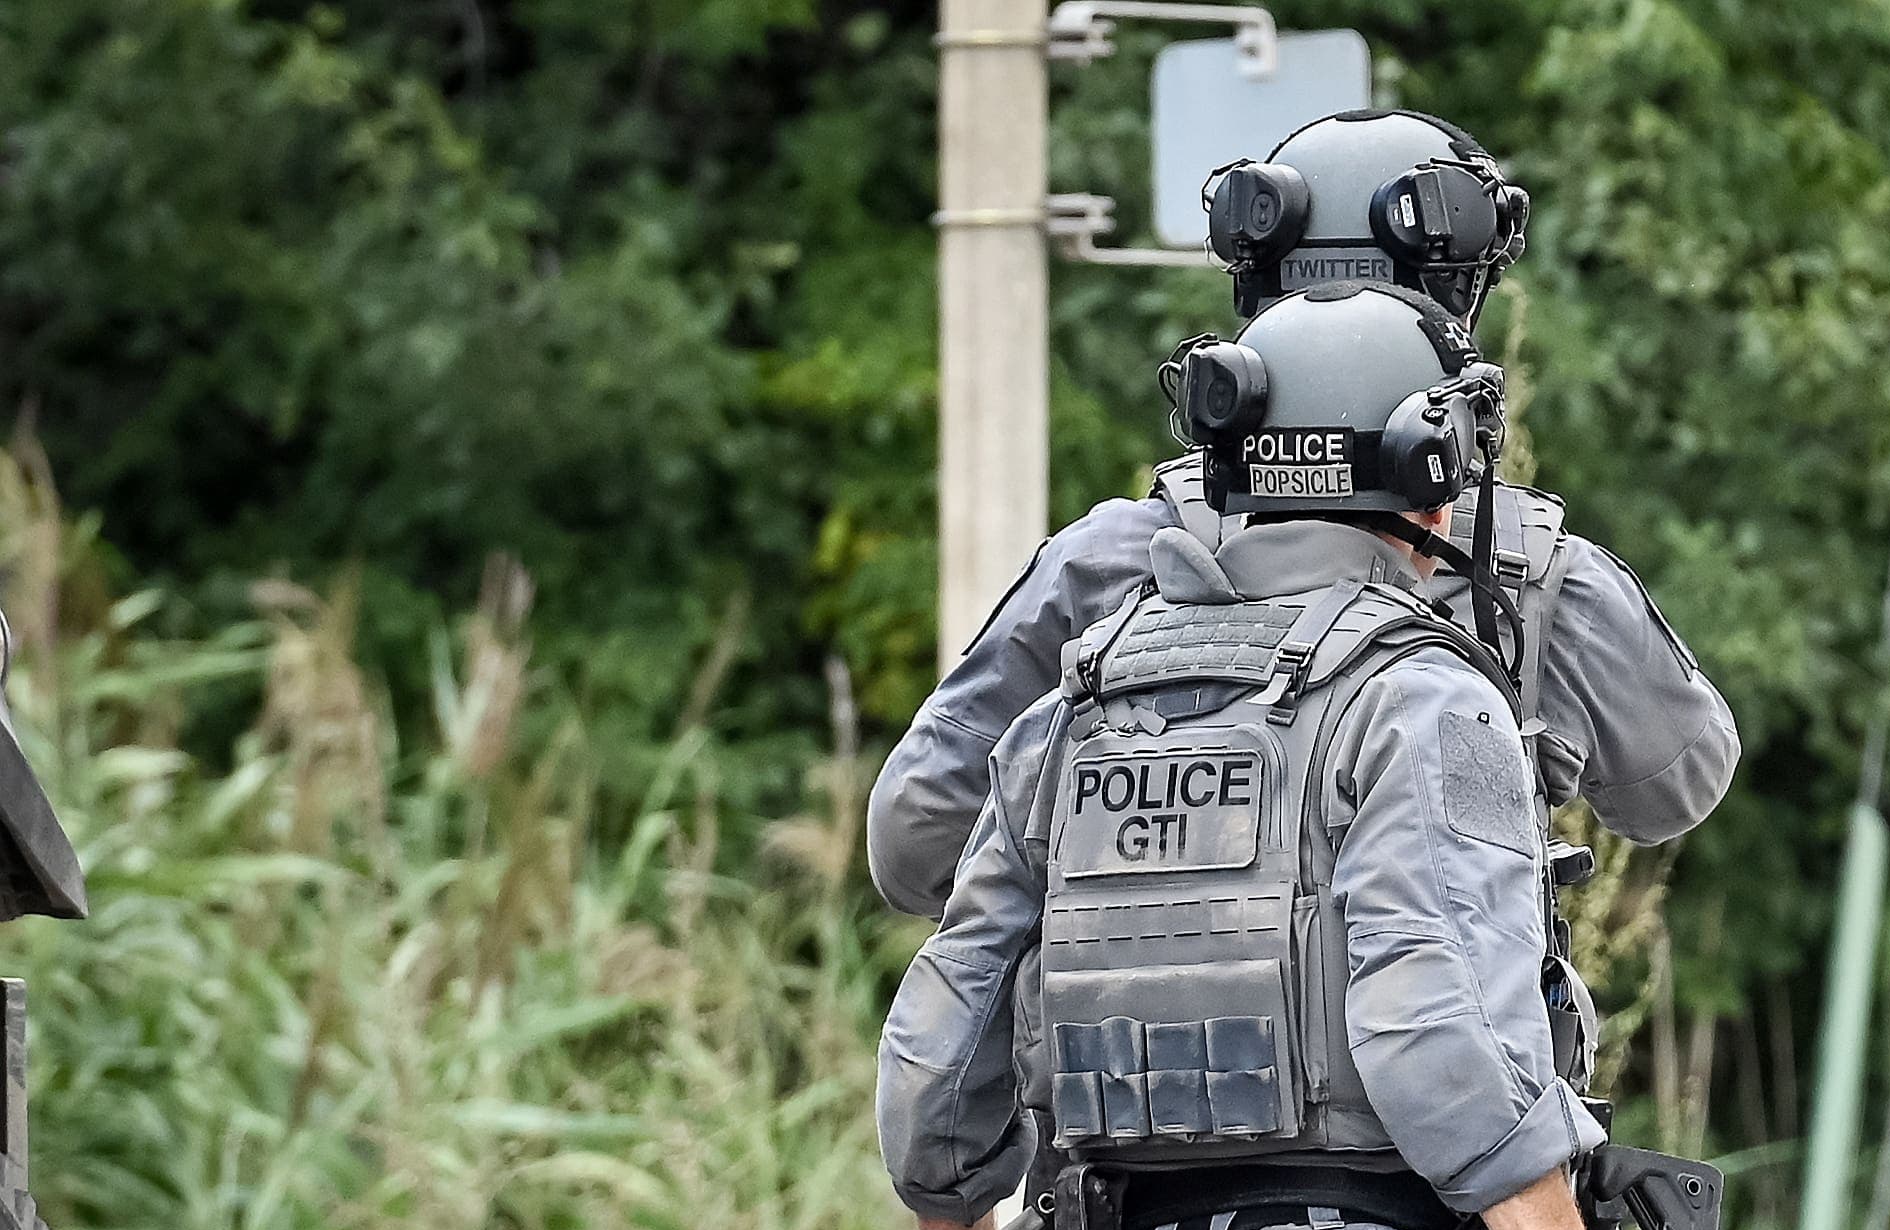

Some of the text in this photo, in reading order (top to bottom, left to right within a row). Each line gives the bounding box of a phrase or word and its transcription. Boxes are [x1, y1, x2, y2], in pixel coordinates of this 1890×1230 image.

[1285, 257, 1389, 280] TWITTER
[1243, 433, 1345, 463] POLICE
[1252, 468, 1351, 494] POPSICLE
[1075, 760, 1253, 814] POLICE
[1117, 815, 1188, 862] GTI
